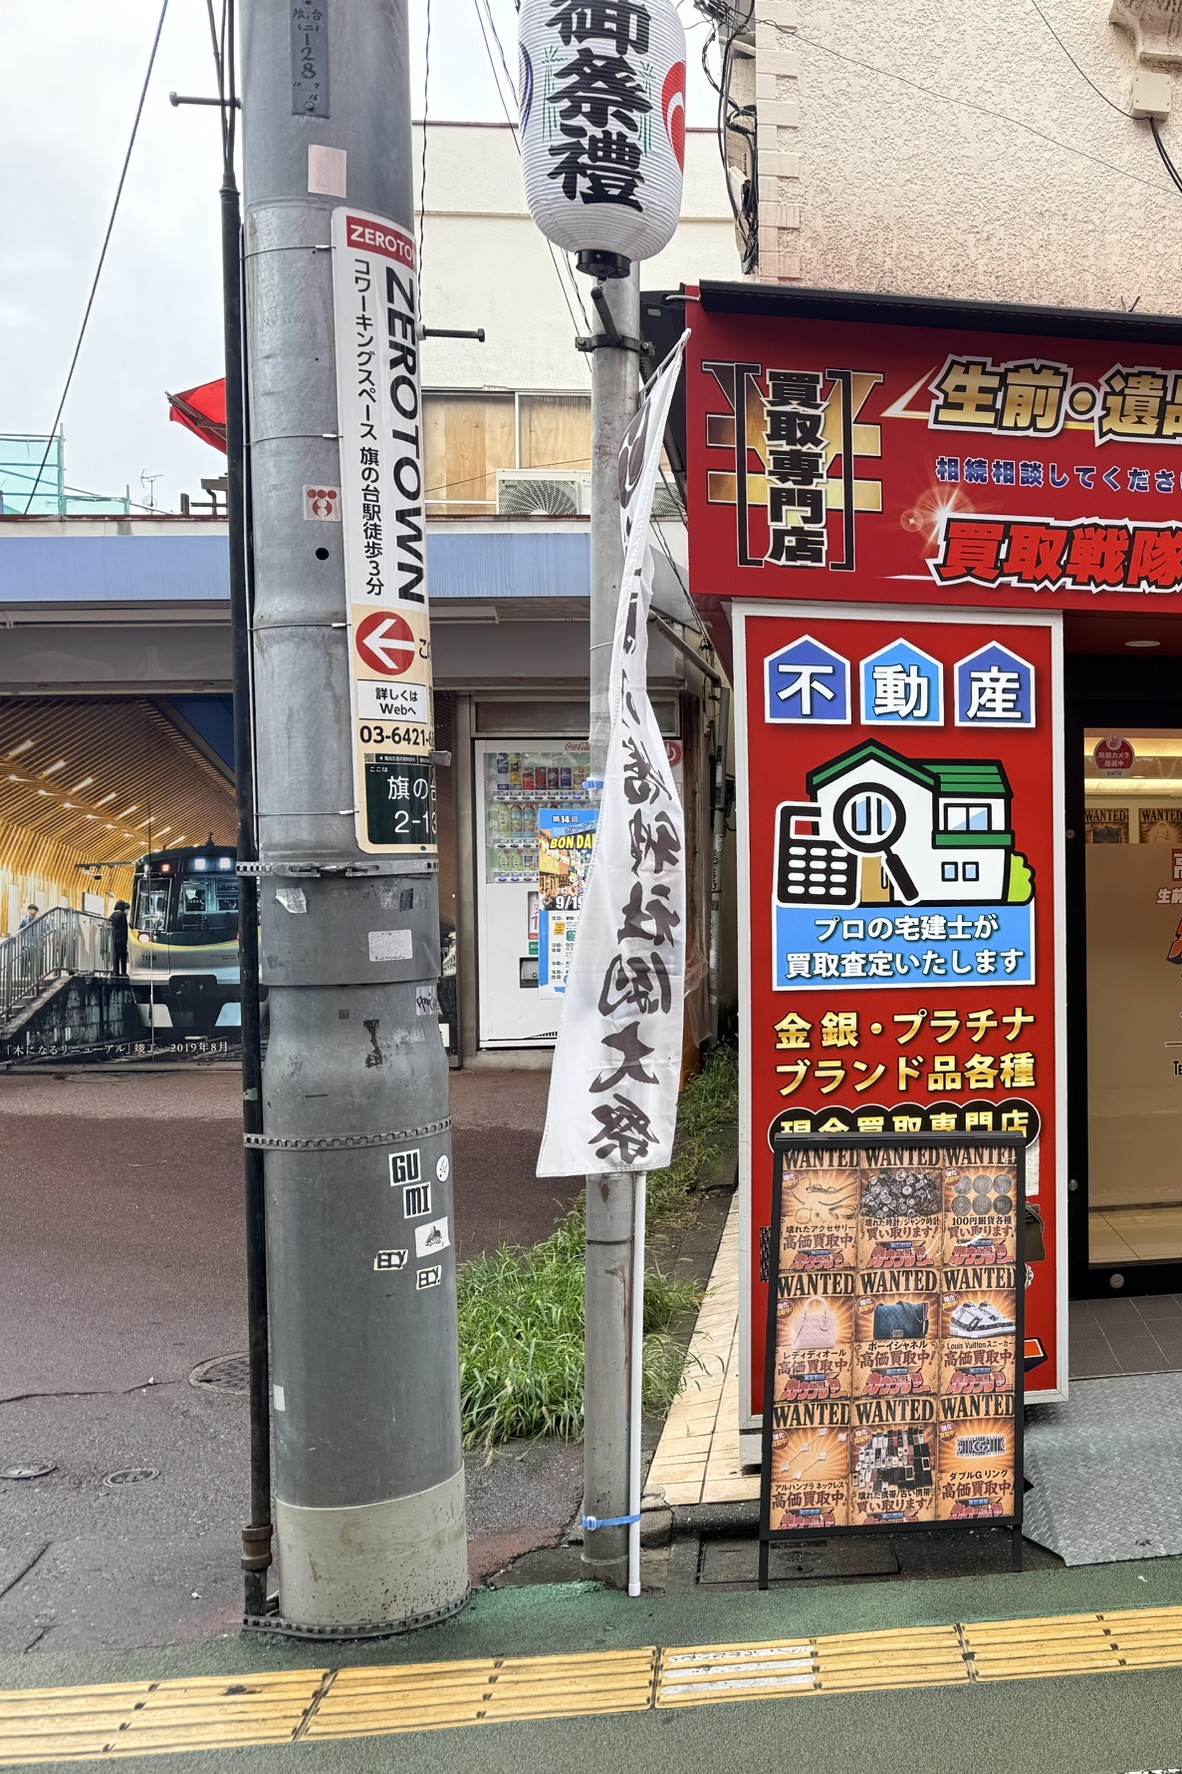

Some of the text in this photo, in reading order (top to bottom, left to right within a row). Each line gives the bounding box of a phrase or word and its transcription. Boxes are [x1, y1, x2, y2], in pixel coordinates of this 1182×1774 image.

[350, 224, 415, 263] ZEROTO
[354, 258, 385, 597] コワーキングスペース 旗の台駅徒歩3分
[385, 265, 426, 605] ZEROTOWN
[760, 368, 829, 569] 買取専門店
[375, 687, 418, 702] 詳しくは
[777, 662, 1023, 721] 不動産
[379, 703, 417, 716] Webへ
[1085, 809, 1127, 821] WANTED
[1141, 809, 1182, 821] WANTED
[549, 835, 574, 850] BON
[814, 913, 999, 942] プロの宅建士が
[786, 948, 1025, 979] 買取査定いたします
[773, 1006, 1036, 1049] 金銀・プラチナ
[170, 1041, 228, 1054] 2019年8月
[775, 1051, 1036, 1097] ブランド品各種
[391, 1152, 419, 1184] GU
[783, 1148, 859, 1169] WANTED
[866, 1146, 941, 1169] WANTED
[946, 1145, 1018, 1167] WANTED
[405, 1184, 430, 1217] MI
[786, 1224, 855, 1233] 壊れたアクセサリー
[952, 1215, 1012, 1225] 100円銀貨各種
[777, 1272, 855, 1298] WANTED
[860, 1269, 938, 1295] WANTED
[942, 1267, 1016, 1292] WANTED
[783, 1350, 847, 1359] レディディオール
[868, 1341, 928, 1351] ボーイシャネル
[946, 1342, 963, 1350] Louis
[773, 1403, 850, 1428] WANTED
[856, 1399, 934, 1425] WANTED
[941, 1395, 1015, 1420] WANTED
